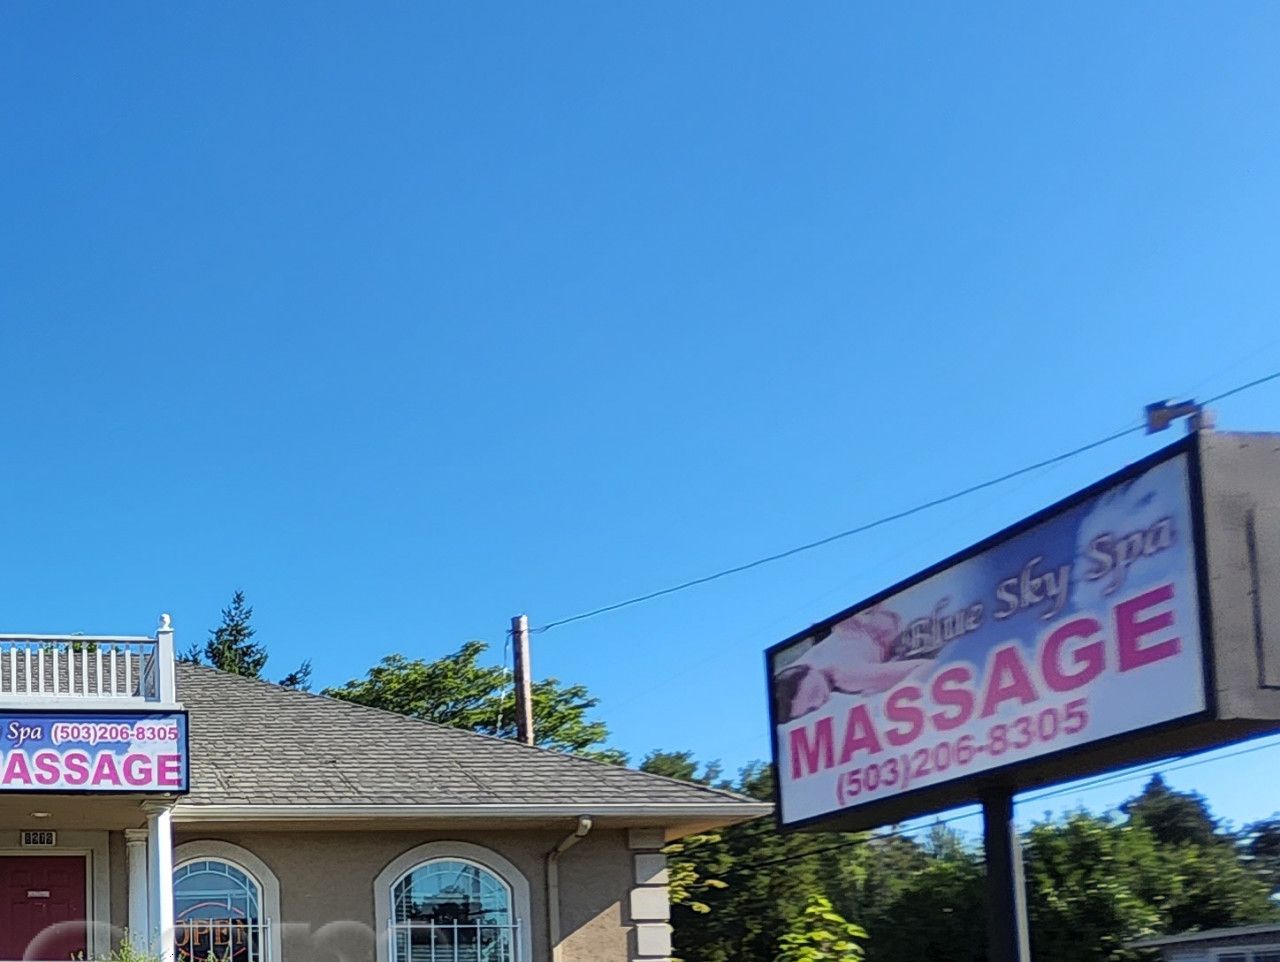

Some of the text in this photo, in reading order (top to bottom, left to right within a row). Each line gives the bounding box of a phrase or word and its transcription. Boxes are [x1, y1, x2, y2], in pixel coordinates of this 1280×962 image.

[898, 515, 1175, 656] Blue Sky Spa
[6, 721, 42, 747] Spa
[51, 723, 179, 745] (503)206-8305
[789, 583, 1182, 780] MASSAGE
[835, 698, 1090, 805] (503)206-8305
